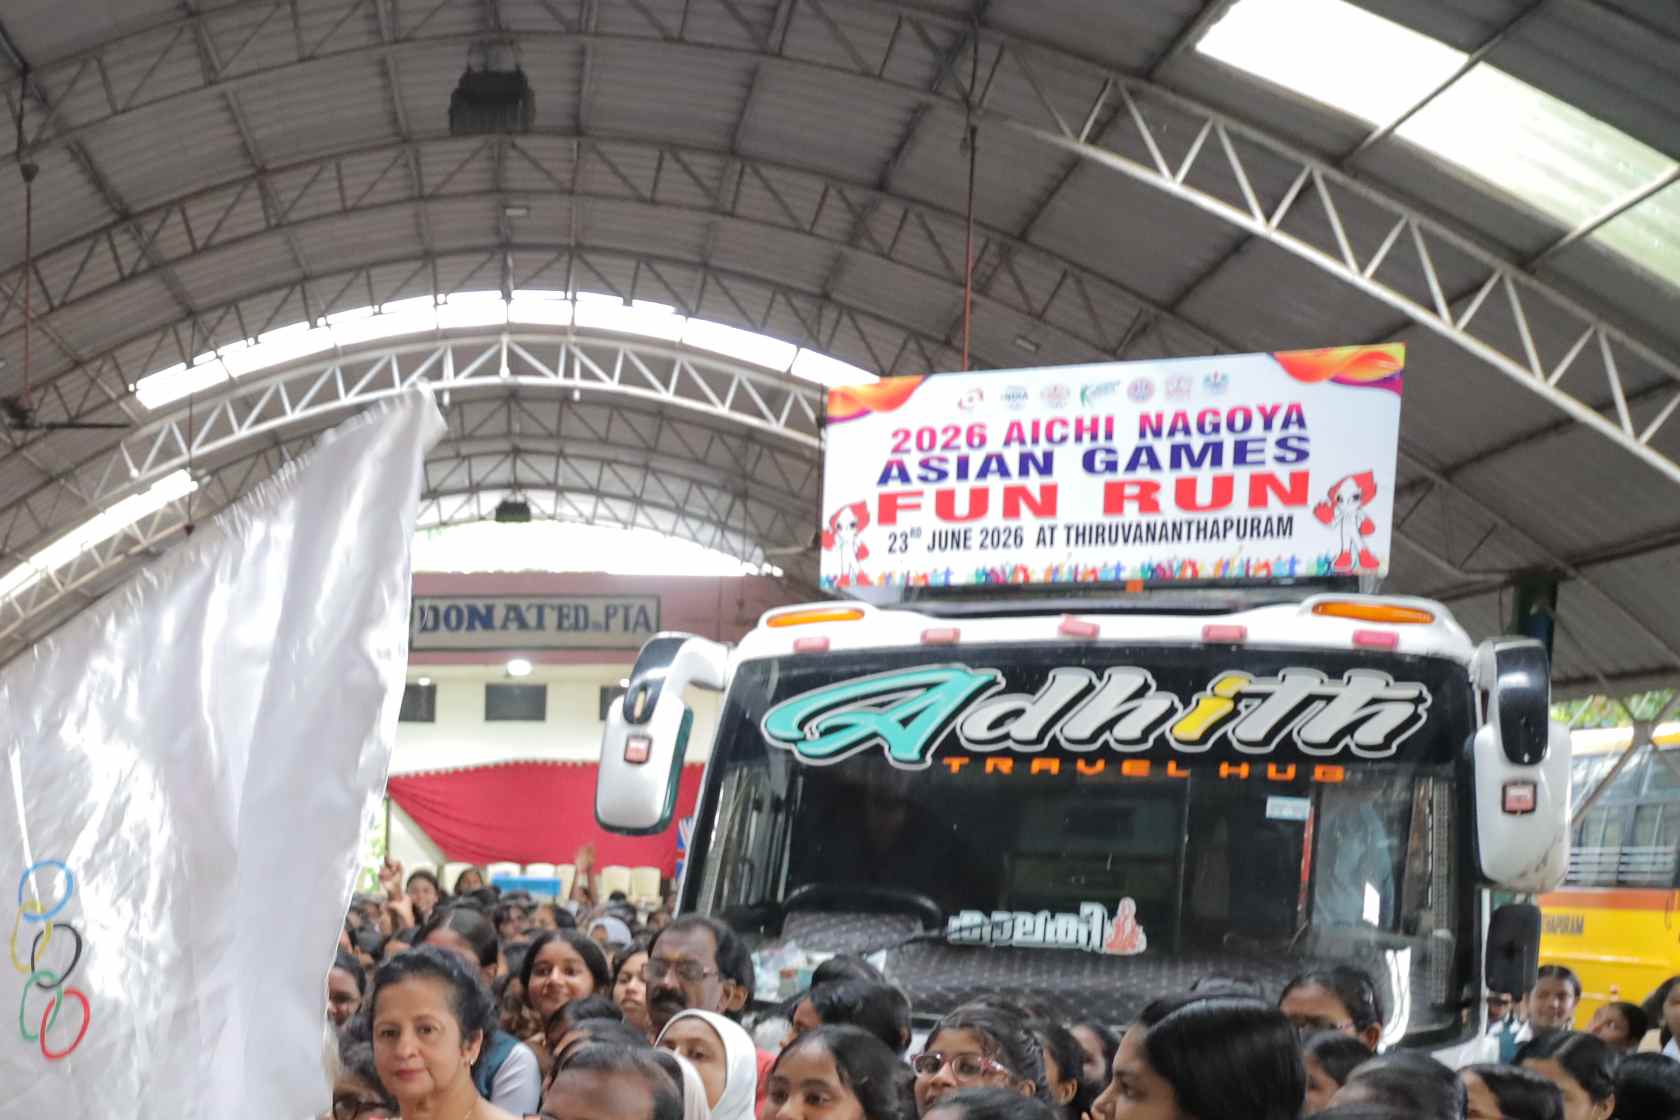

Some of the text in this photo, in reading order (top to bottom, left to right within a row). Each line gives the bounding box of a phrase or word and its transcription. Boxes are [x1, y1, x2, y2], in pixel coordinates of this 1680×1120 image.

[890, 401, 1309, 455] 2026 AICHI NAGOYA
[875, 435, 1311, 487] ASIAN GAMES
[876, 471, 1310, 526] FUN RUN
[926, 527, 973, 554] JUNE
[978, 524, 1025, 551] 2026
[1035, 523, 1058, 549] AT
[1063, 514, 1295, 549] THIRUVANANTHAPURAM
[418, 602, 591, 633] DONATED
[942, 756, 1346, 783] TRAVEL HUB
